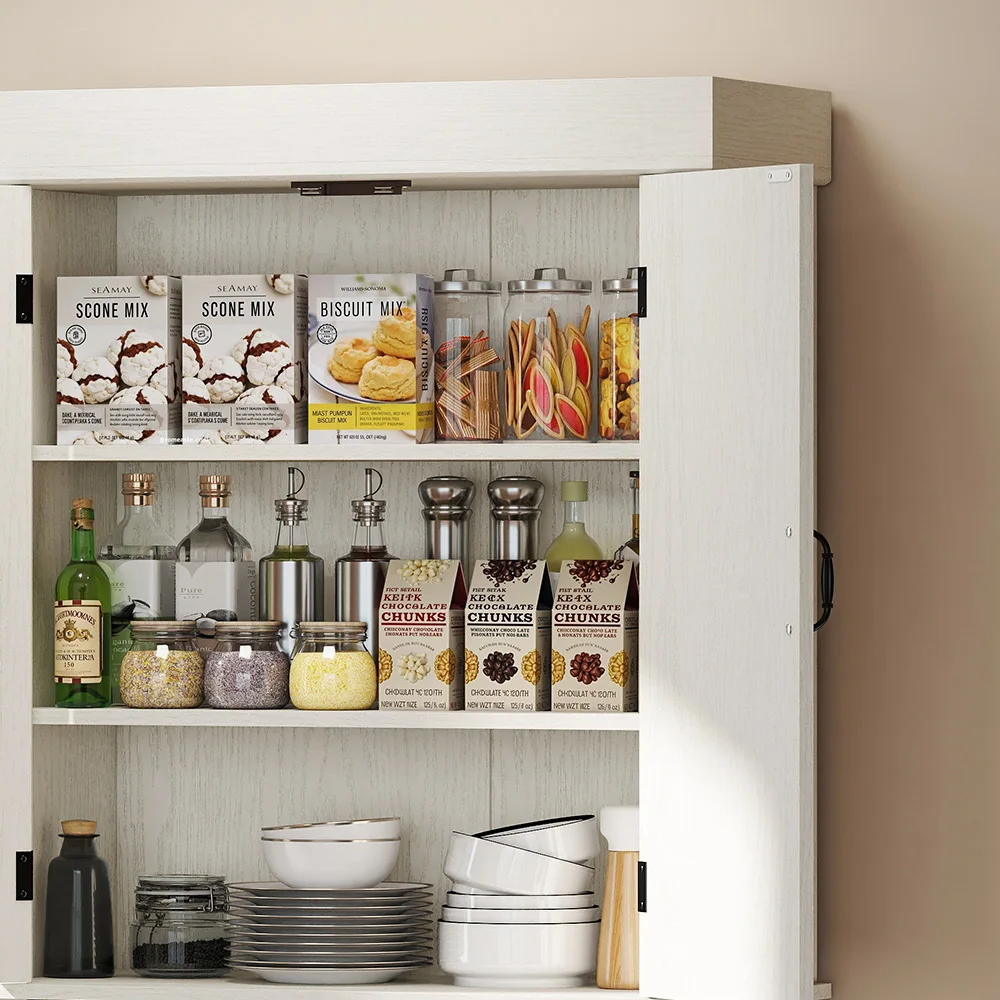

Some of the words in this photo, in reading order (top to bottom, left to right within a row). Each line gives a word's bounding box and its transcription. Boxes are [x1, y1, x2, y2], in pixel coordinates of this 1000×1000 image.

[76, 302, 118, 318] SCONE
[125, 302, 148, 318] MIX
[202, 301, 245, 317] SCONE
[251, 301, 275, 317] MIX
[320, 301, 373, 317] BISCUIT
[380, 301, 403, 316] MIX
[381, 612, 446, 622] CHUNKS
[468, 612, 533, 622] CHUNKS
[554, 613, 621, 623] CHUNKS
